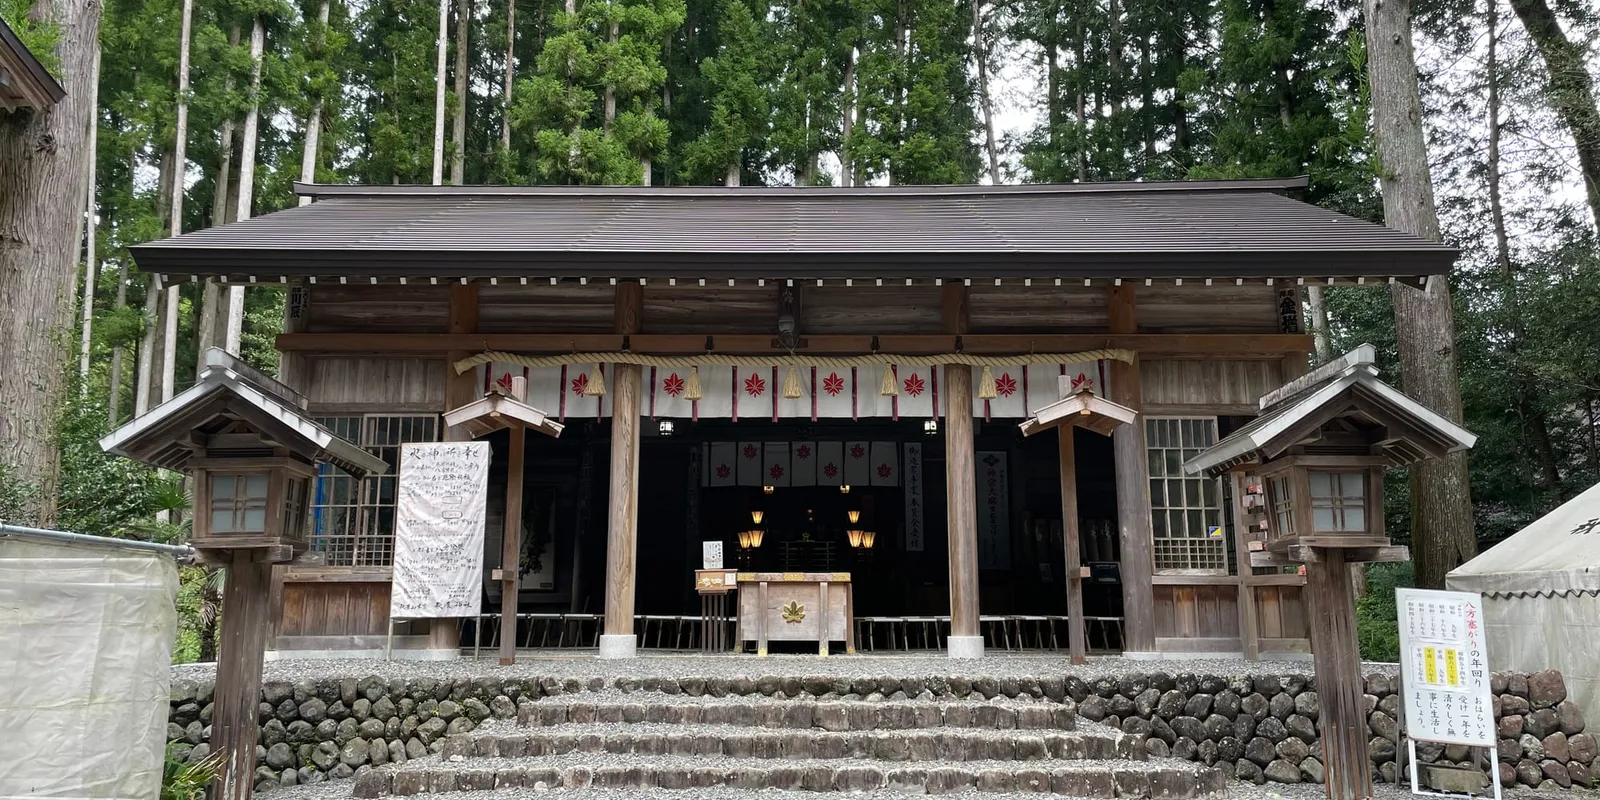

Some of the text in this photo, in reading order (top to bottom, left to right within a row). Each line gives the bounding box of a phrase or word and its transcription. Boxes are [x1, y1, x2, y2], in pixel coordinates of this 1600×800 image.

[1465, 602, 1483, 688] 八方塞がりの年回り
[1415, 691, 1426, 729] ましょう。
[1429, 692, 1440, 735] 事に生活し
[1443, 693, 1456, 737] 清々しく無
[1458, 695, 1471, 738] 受け一年を
[1474, 696, 1486, 740] おはらいを
